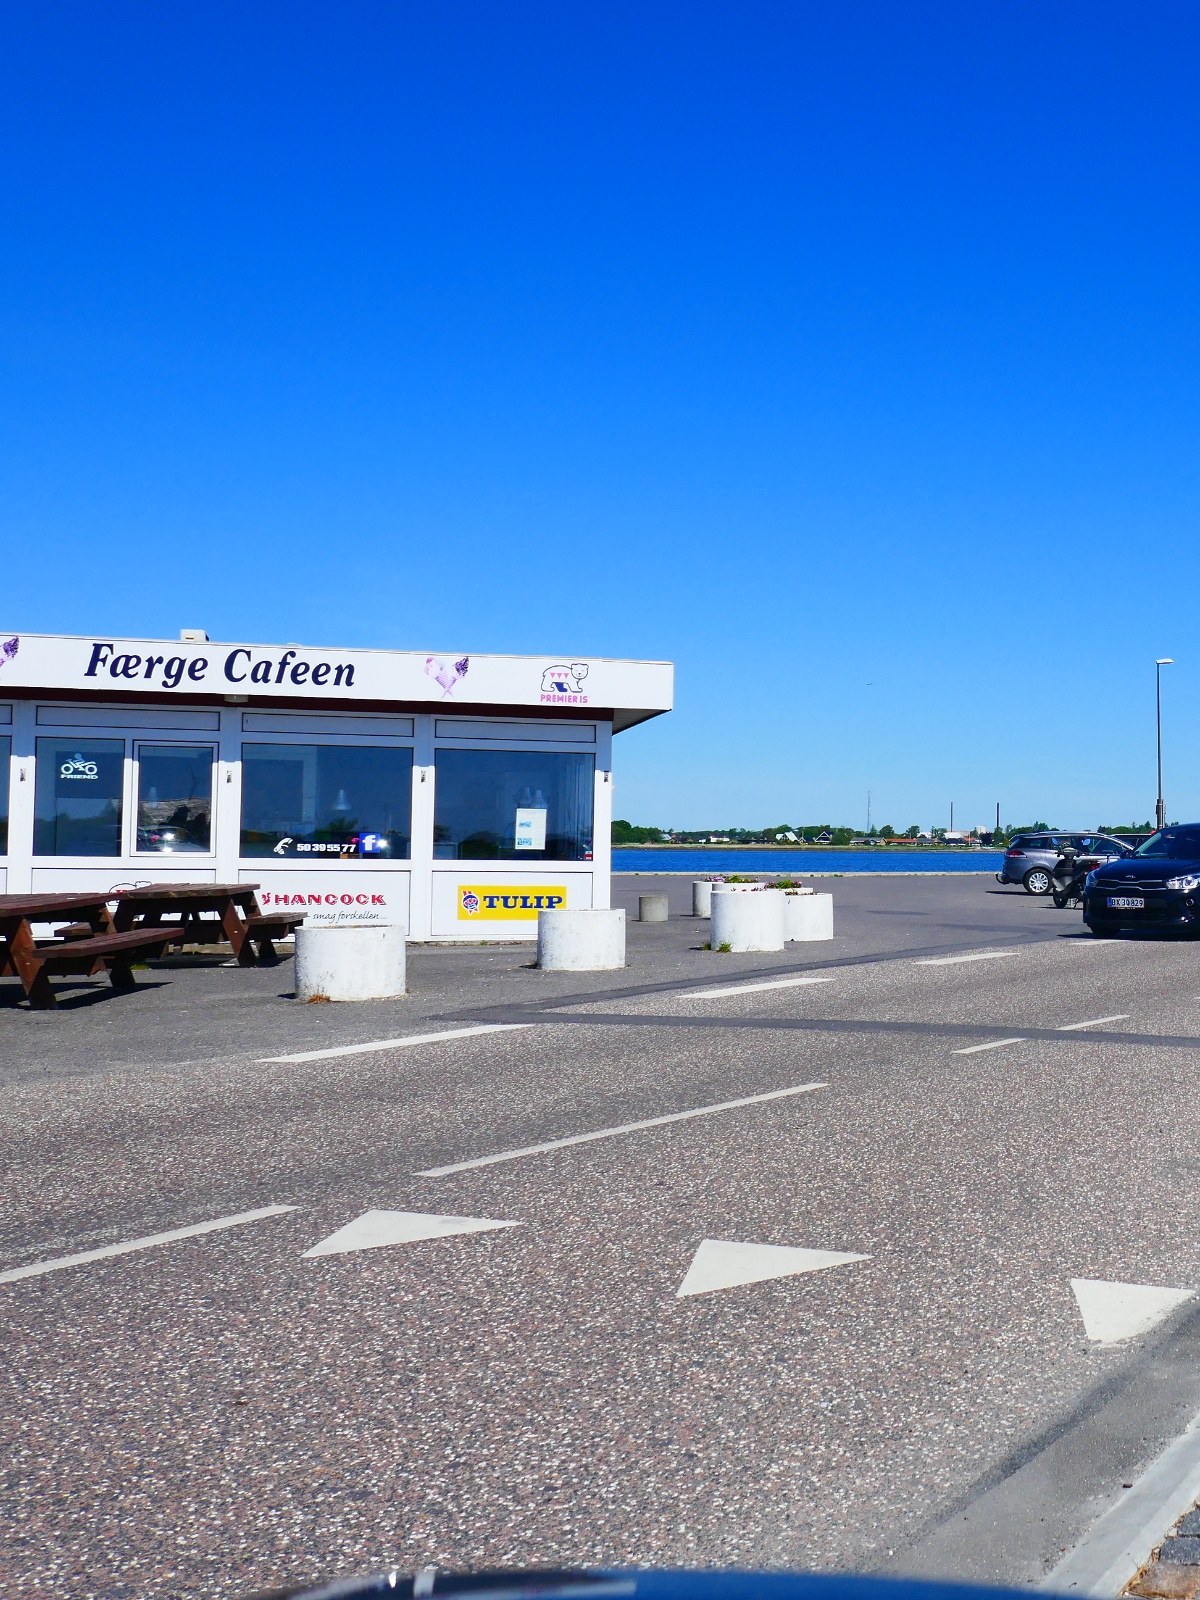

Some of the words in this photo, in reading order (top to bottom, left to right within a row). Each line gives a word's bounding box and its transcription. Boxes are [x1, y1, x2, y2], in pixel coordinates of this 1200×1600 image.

[84, 643, 208, 688] Færge
[224, 649, 355, 687] Cafeen
[540, 694, 578, 703] PREMIER
[297, 844, 310, 852] 50
[312, 844, 326, 852] 39
[327, 844, 340, 852] 55
[341, 844, 356, 853] 77
[274, 894, 386, 905] HANCOCK
[483, 896, 563, 909] TULIP
[1122, 899, 1130, 907] 30
[1131, 899, 1143, 907] 829
[313, 913, 336, 923] smag
